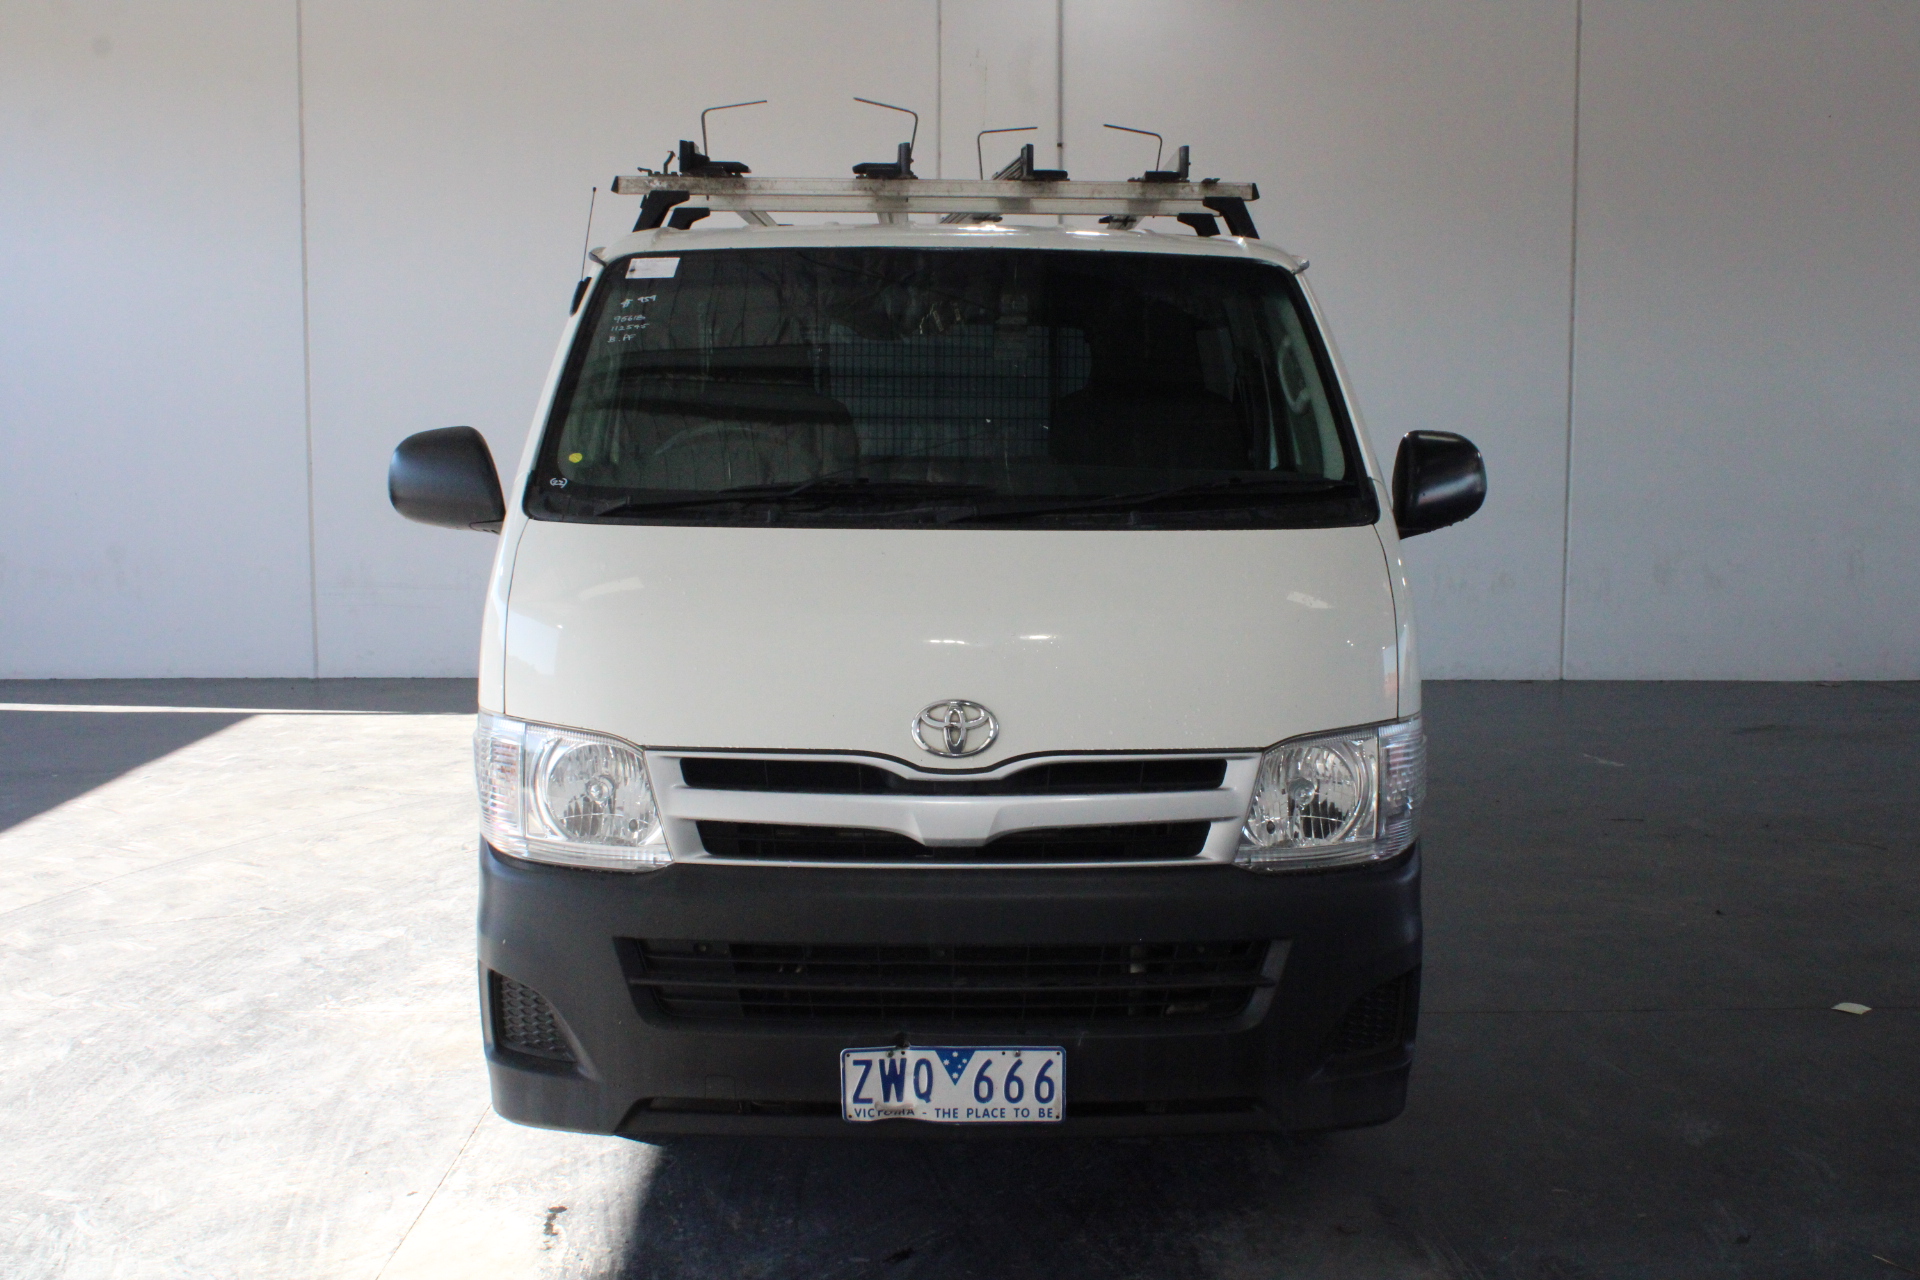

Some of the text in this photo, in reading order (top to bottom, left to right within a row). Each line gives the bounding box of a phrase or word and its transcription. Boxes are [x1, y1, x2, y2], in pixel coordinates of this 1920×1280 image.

[852, 1057, 1055, 1104] ZWQ 666
[934, 1107, 959, 1119] THE
[966, 1107, 1006, 1119] PLACE
[1013, 1107, 1030, 1119] TO
[1038, 1107, 1053, 1119] BE
